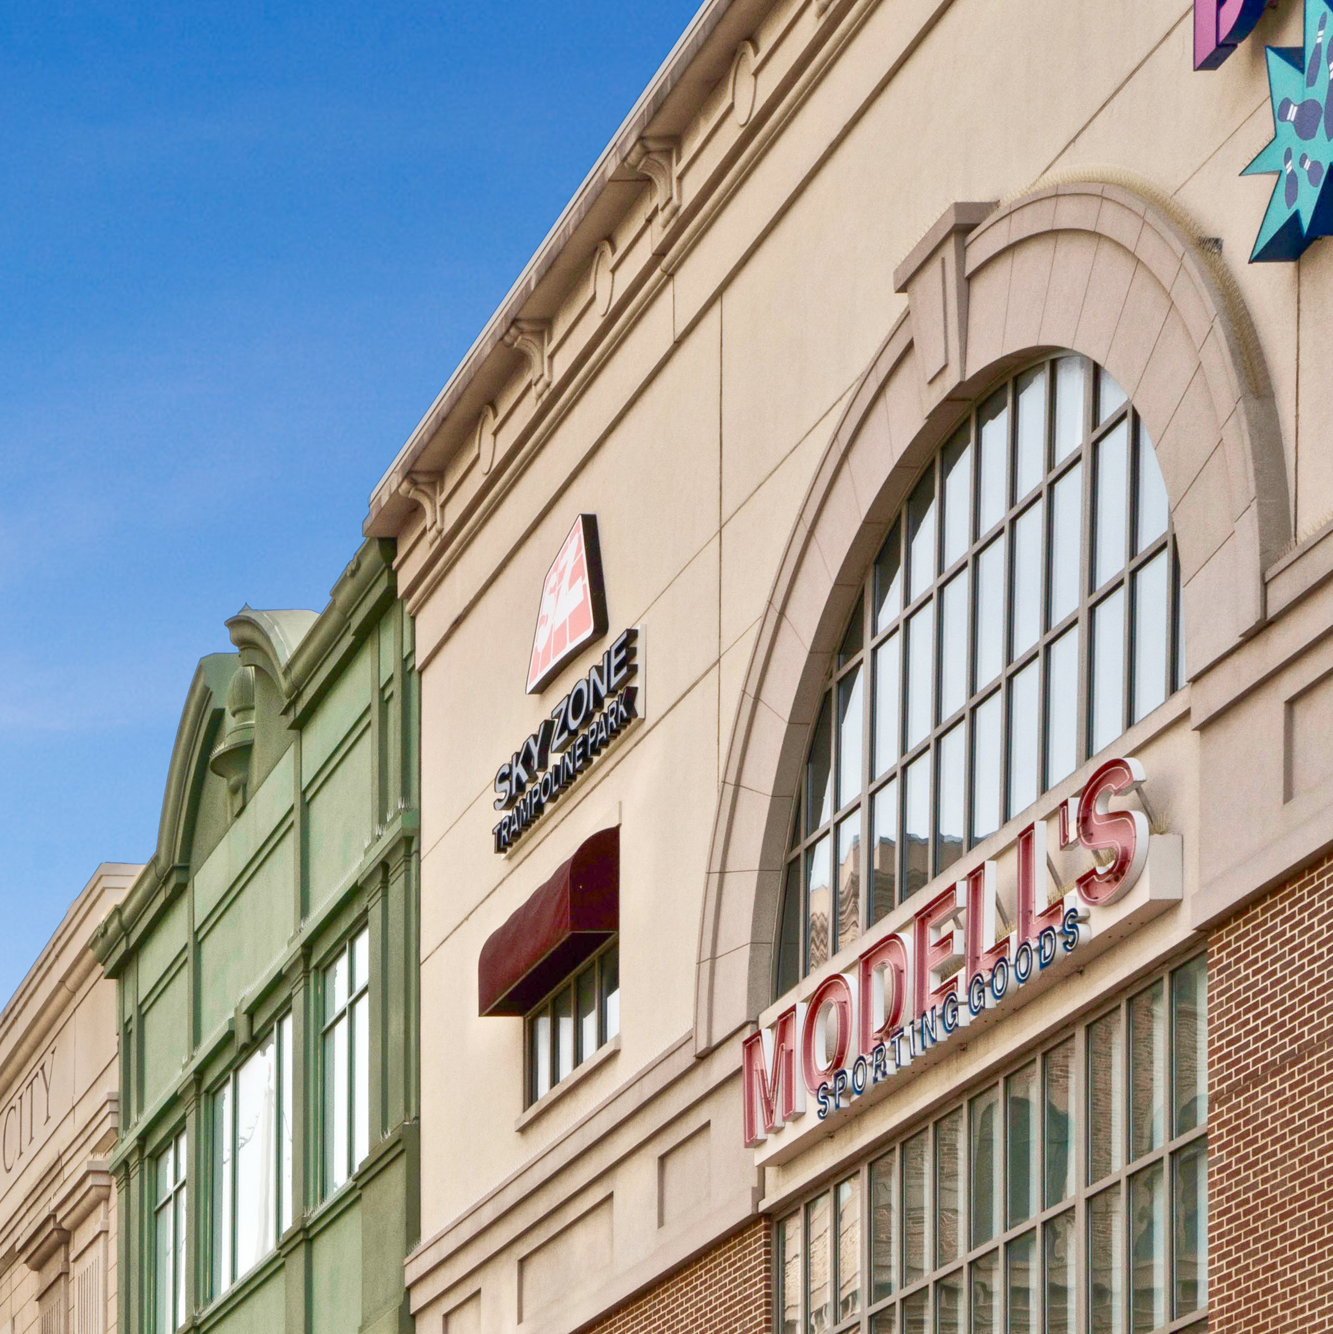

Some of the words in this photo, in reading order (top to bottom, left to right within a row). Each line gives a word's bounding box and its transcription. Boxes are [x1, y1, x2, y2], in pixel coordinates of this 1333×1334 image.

[492, 734, 589, 853] TRAMPOLINE
[587, 687, 637, 757] PARK
[494, 720, 555, 811] SKY
[551, 630, 636, 752] ZONE
[742, 757, 1149, 1148] MODELL'S
[817, 990, 965, 1120] SPORTING
[968, 908, 1089, 1016] GOODS
[3, 1046, 57, 1173] CITY
